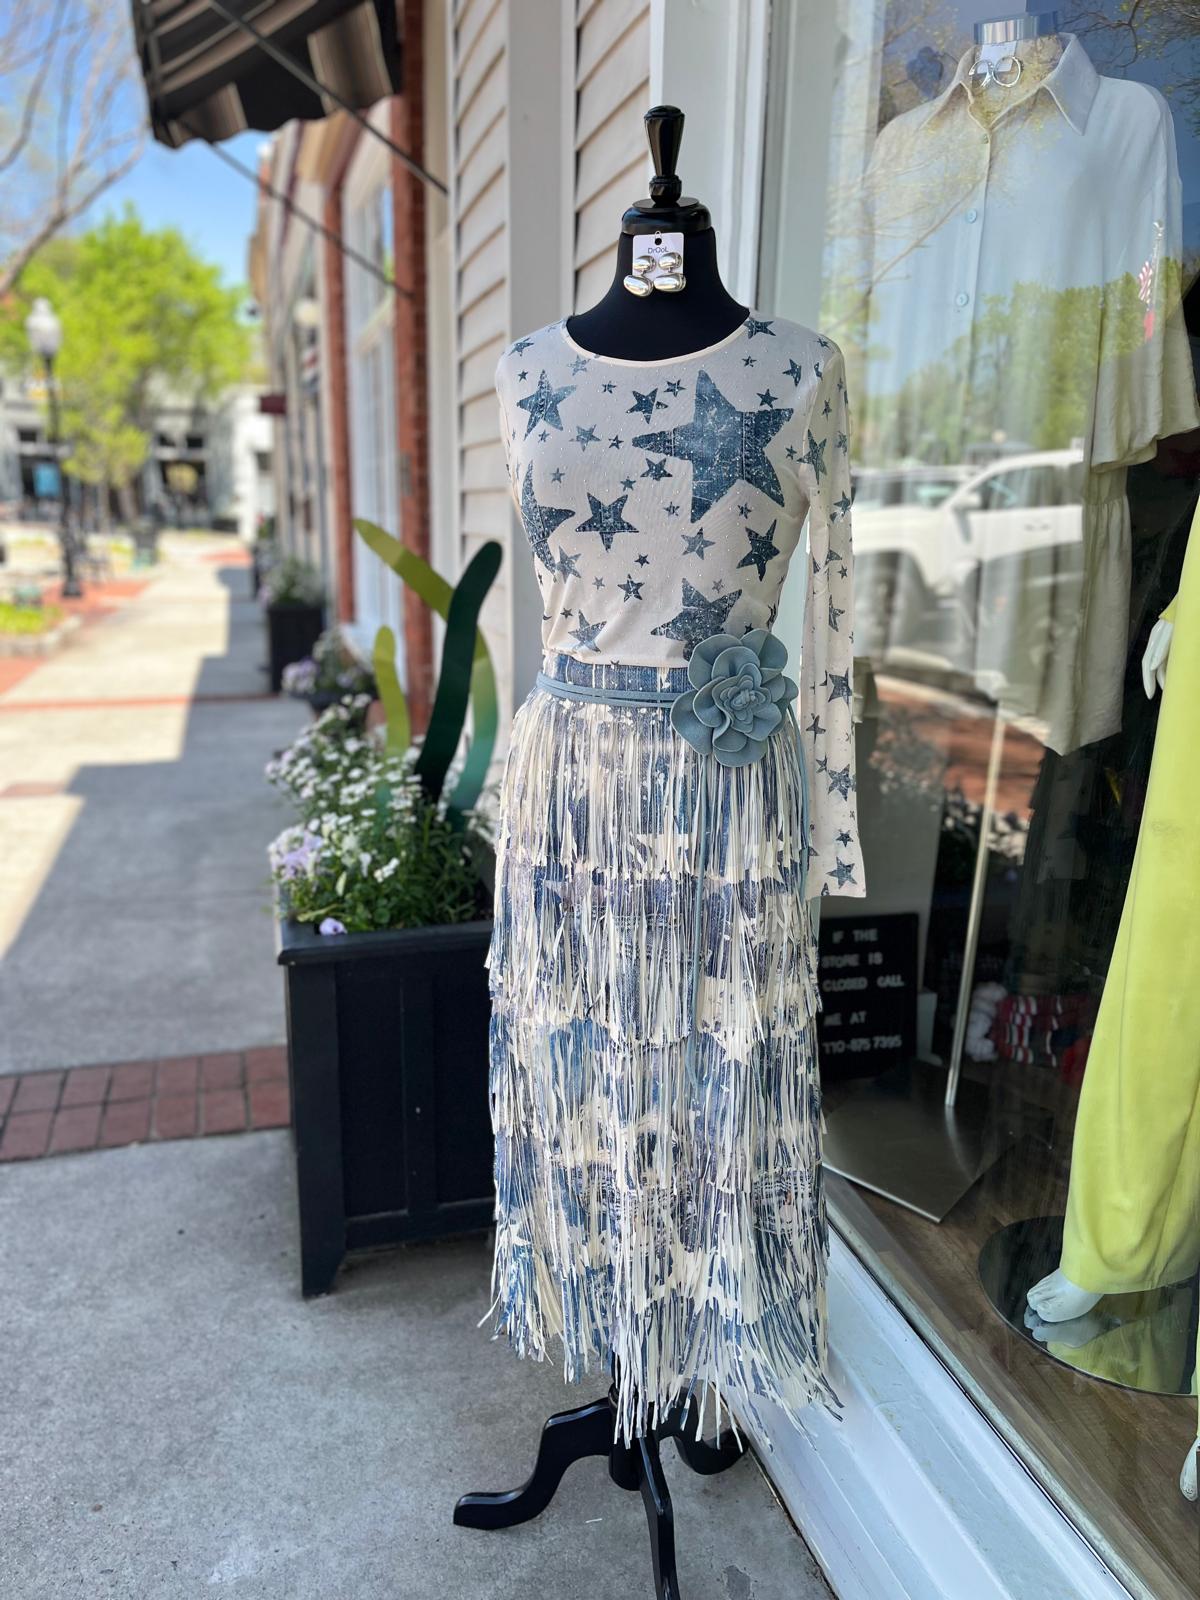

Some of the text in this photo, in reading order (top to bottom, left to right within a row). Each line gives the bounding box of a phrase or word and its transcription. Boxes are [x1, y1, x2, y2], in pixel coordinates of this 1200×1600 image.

[832, 928, 878, 943] IF THE
[821, 952, 883, 968] STORE IS
[822, 974, 905, 992] CLOSED CALL
[849, 1010, 867, 1025] AT
